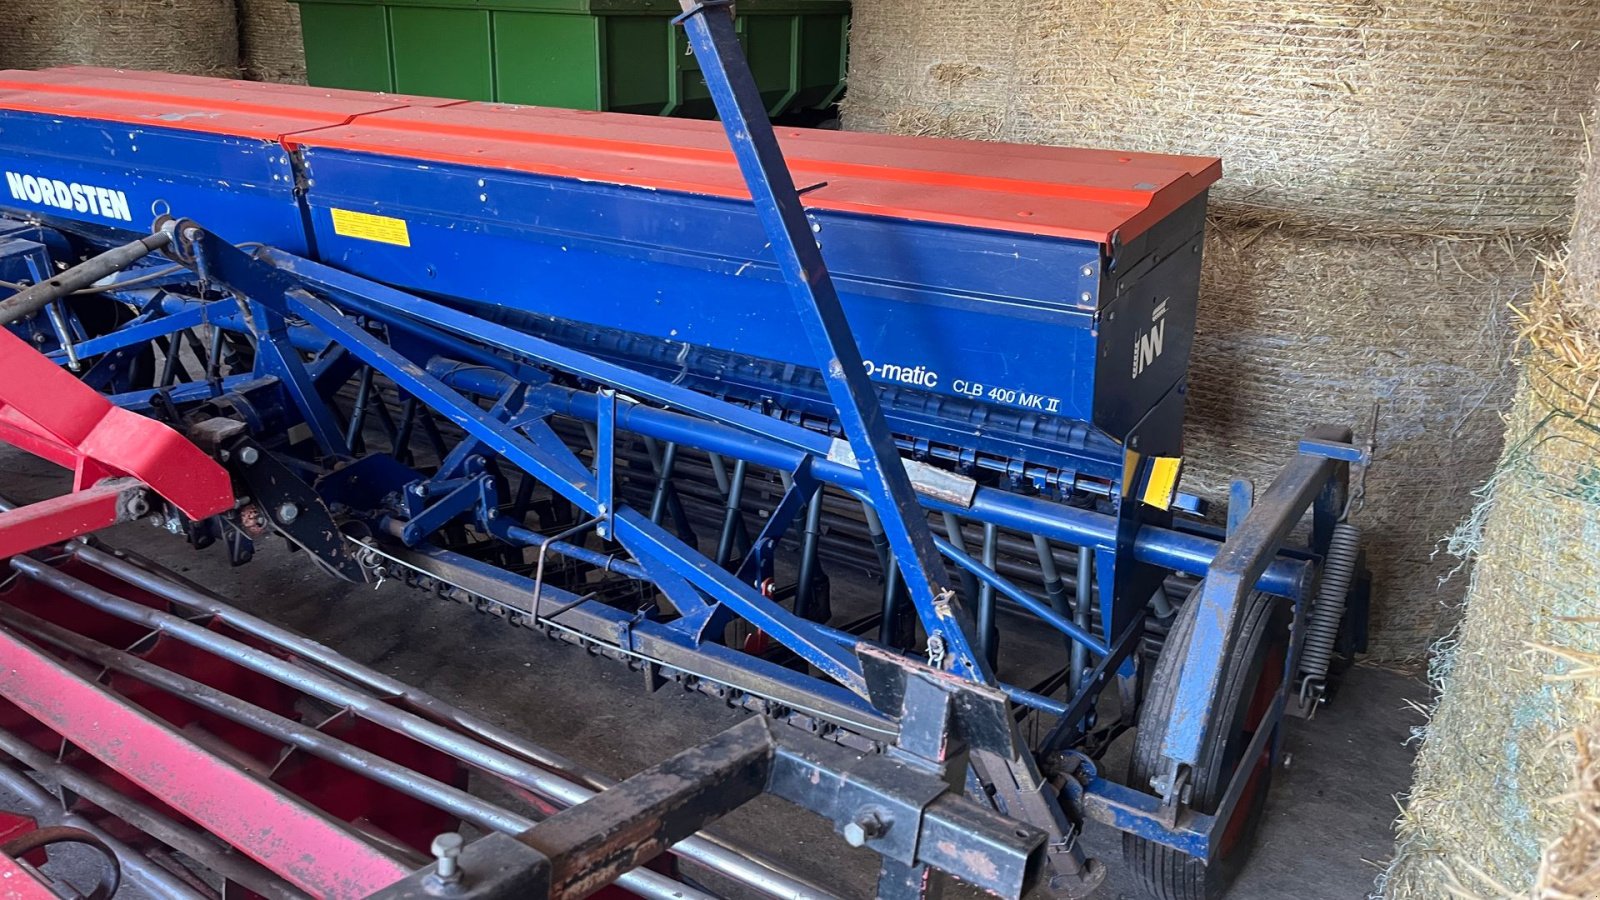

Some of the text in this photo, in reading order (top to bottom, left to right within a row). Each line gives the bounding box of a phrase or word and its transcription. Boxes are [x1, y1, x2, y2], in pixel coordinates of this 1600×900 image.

[5, 171, 132, 222] NORDSTEN
[952, 379, 984, 397] CLB
[988, 387, 1016, 404] 400
[1018, 392, 1043, 409] MK
